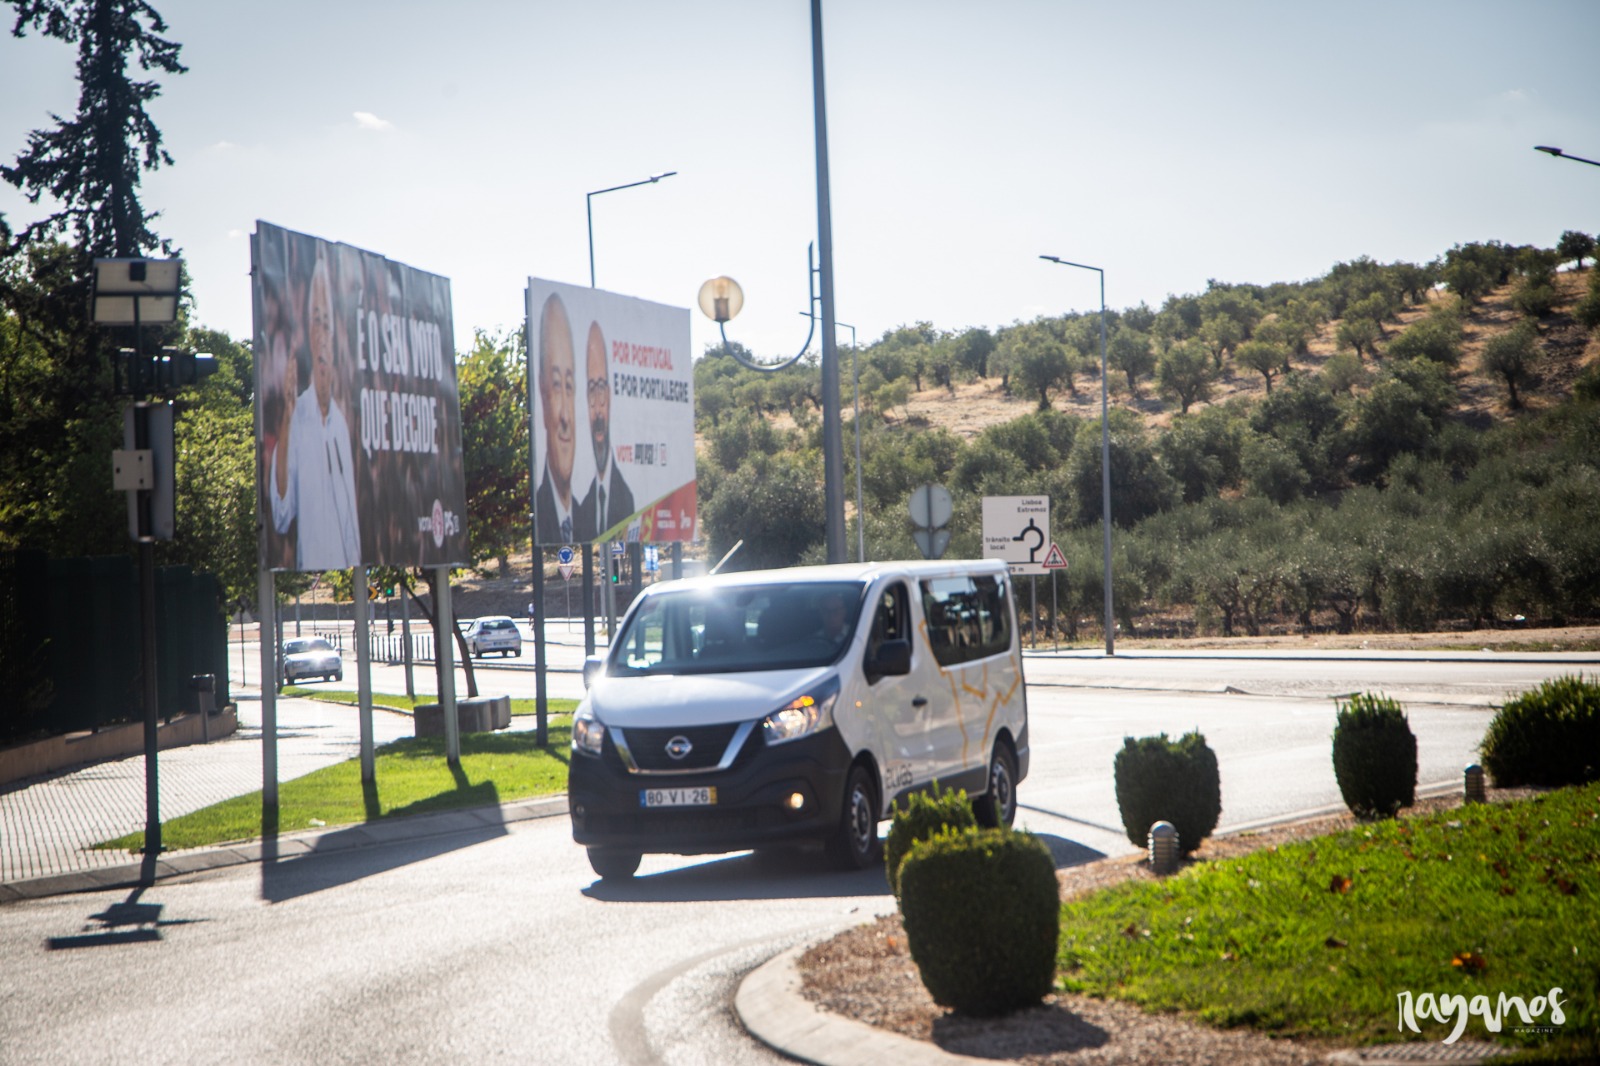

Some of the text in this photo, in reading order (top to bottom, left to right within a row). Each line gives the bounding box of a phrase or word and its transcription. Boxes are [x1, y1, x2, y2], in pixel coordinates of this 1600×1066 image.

[357, 290, 443, 382] É O SEU VOTO
[612, 340, 673, 371] POR PORTUGAL
[614, 372, 689, 403] E POR PORTALEGRE
[360, 387, 438, 459] QUE DECIDE
